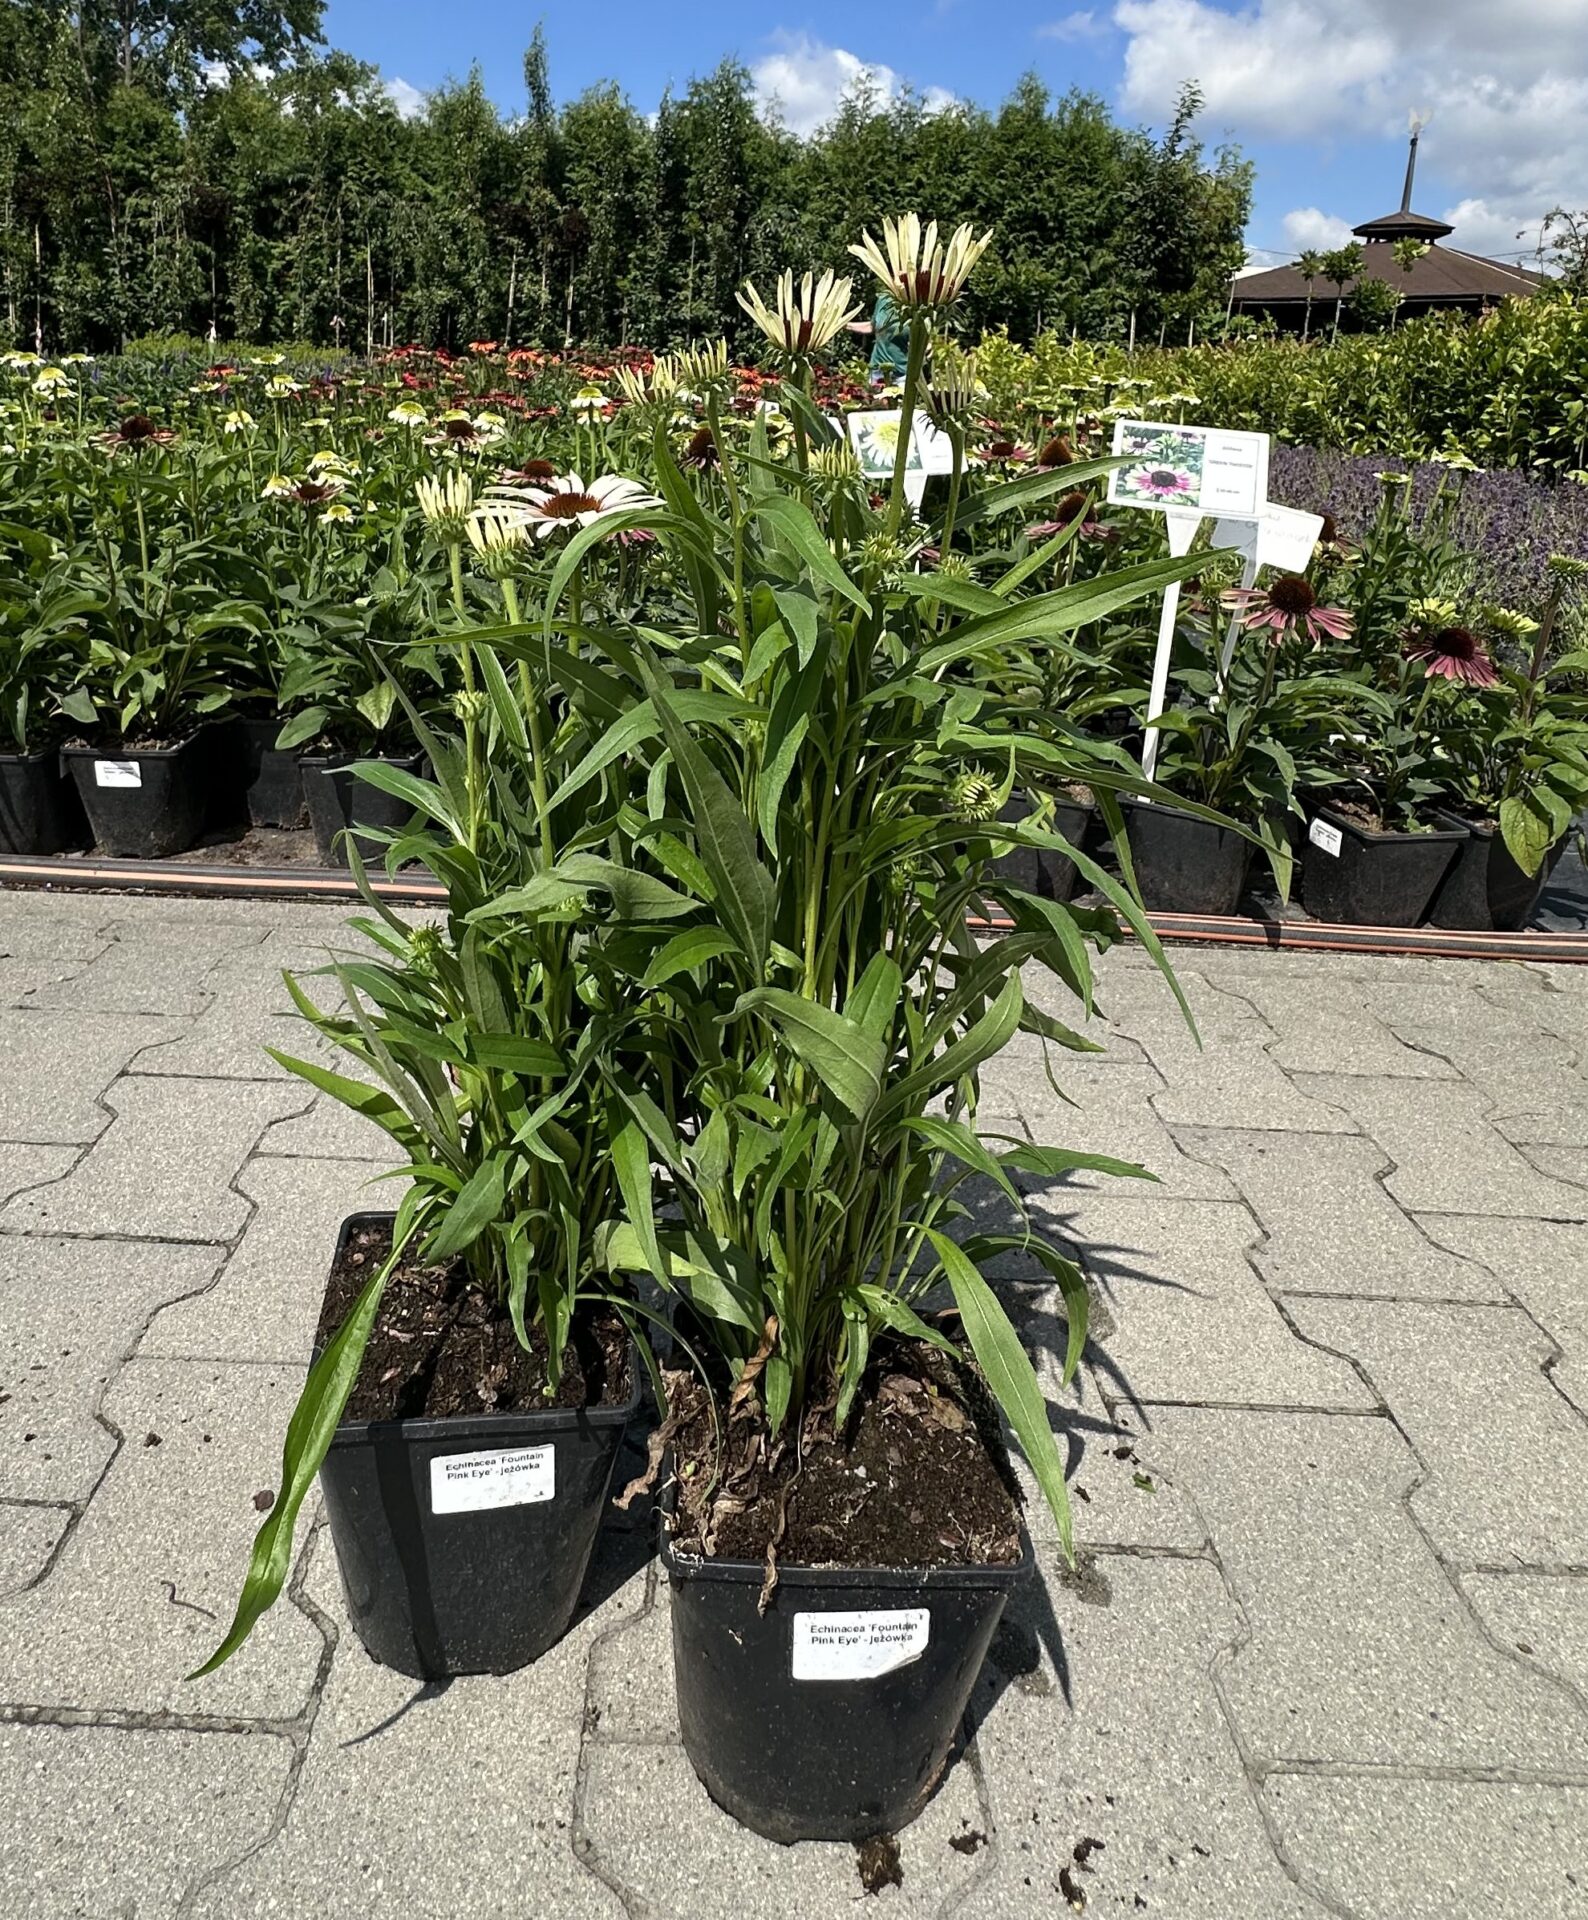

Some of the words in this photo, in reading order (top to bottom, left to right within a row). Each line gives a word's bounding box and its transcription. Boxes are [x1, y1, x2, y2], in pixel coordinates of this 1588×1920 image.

[446, 1459, 496, 1471] Echinacea
[447, 1471, 469, 1480] Pink
[810, 1625, 865, 1634] Echinacea
[811, 1636, 835, 1645] Pink
